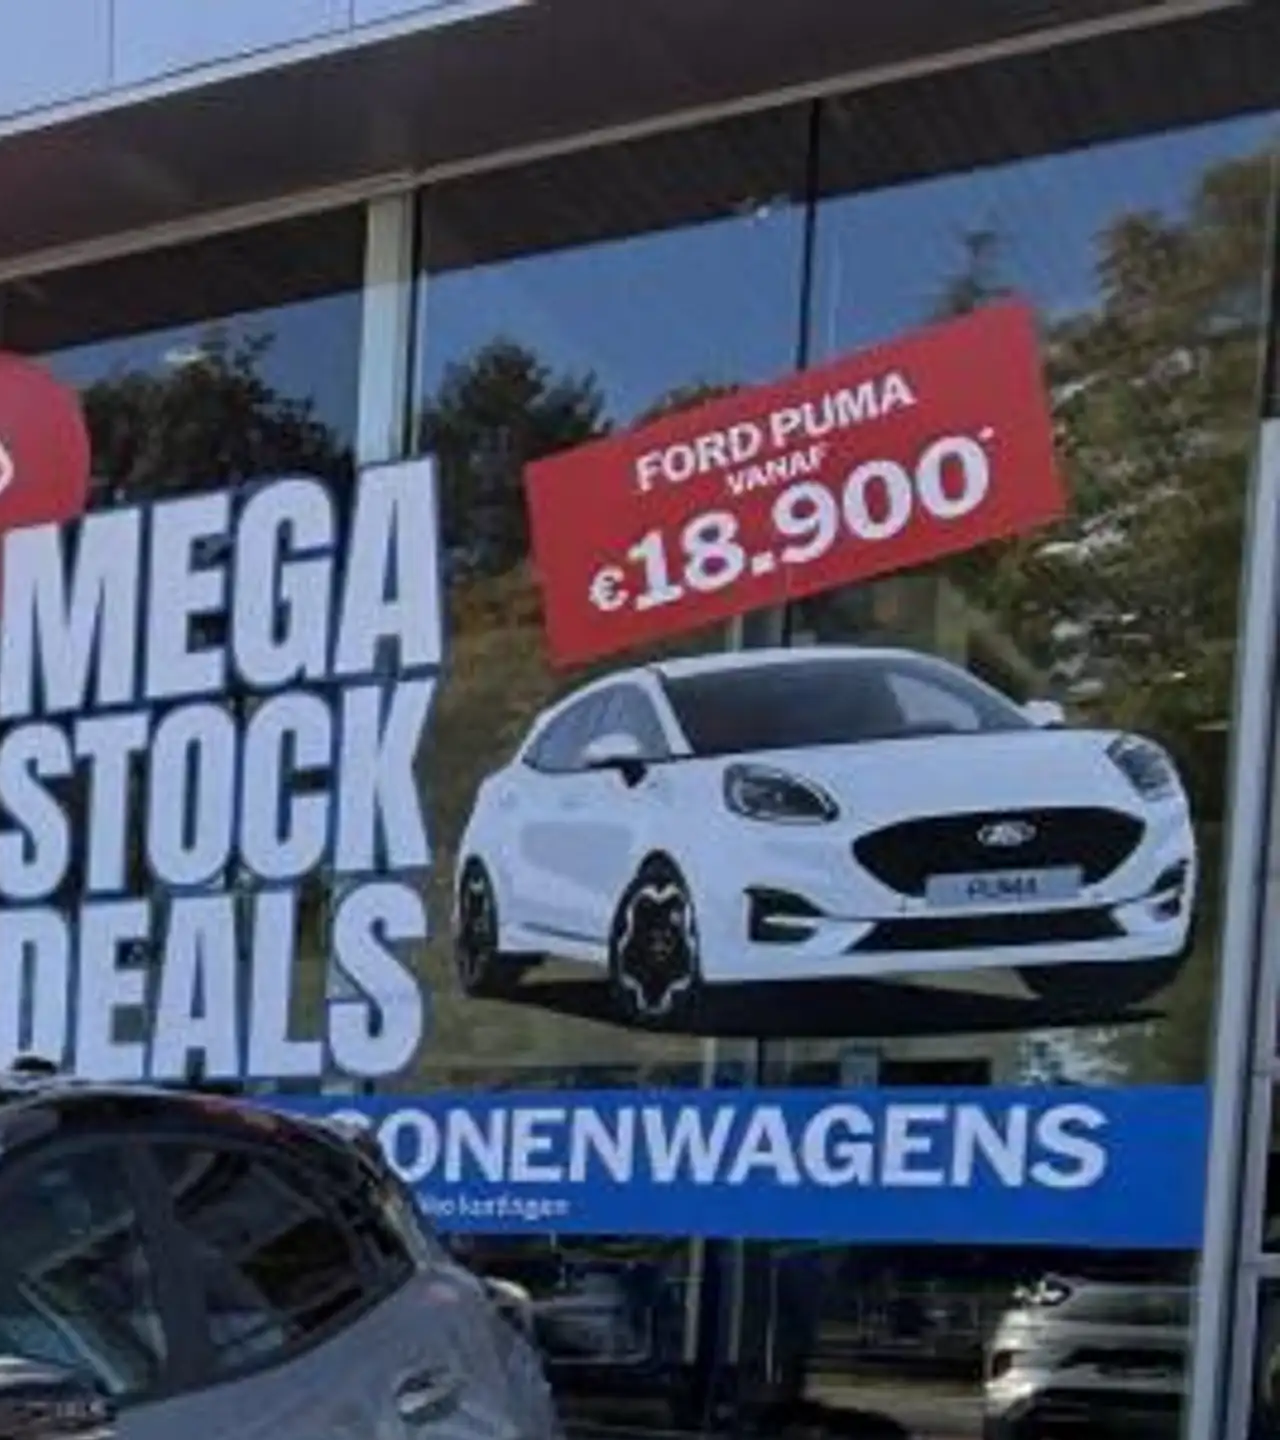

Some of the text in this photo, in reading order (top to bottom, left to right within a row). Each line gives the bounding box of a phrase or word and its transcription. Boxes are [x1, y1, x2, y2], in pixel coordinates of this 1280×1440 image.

[635, 371, 917, 492] FORD PUMA
[725, 445, 830, 498] VANAF
[327, 1104, 1109, 1191] ONENWAGENS
